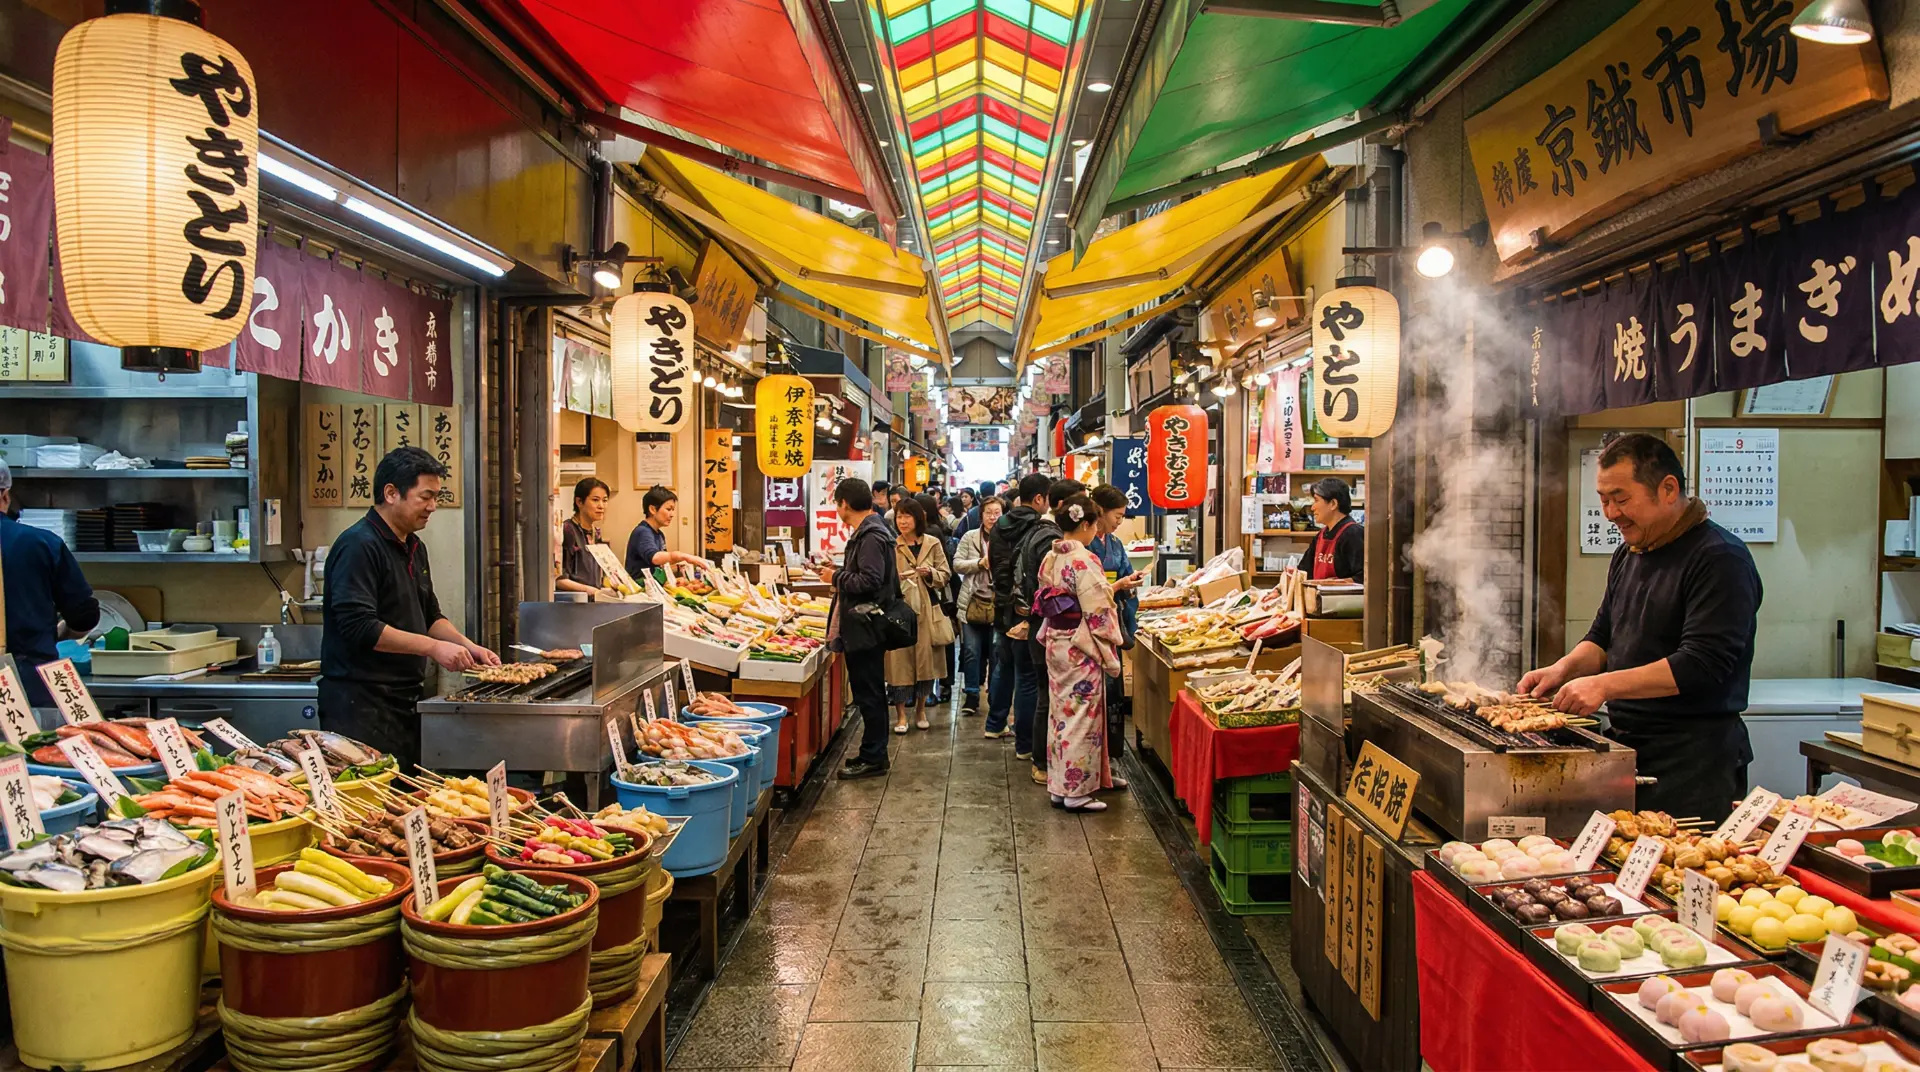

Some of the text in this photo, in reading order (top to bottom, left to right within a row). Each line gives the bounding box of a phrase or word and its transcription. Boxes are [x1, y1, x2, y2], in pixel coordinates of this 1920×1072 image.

[169, 52, 251, 320] やきとり
[645, 304, 688, 425] やきどり
[1319, 301, 1364, 422] やとり
[1736, 439, 1744, 449] 9
